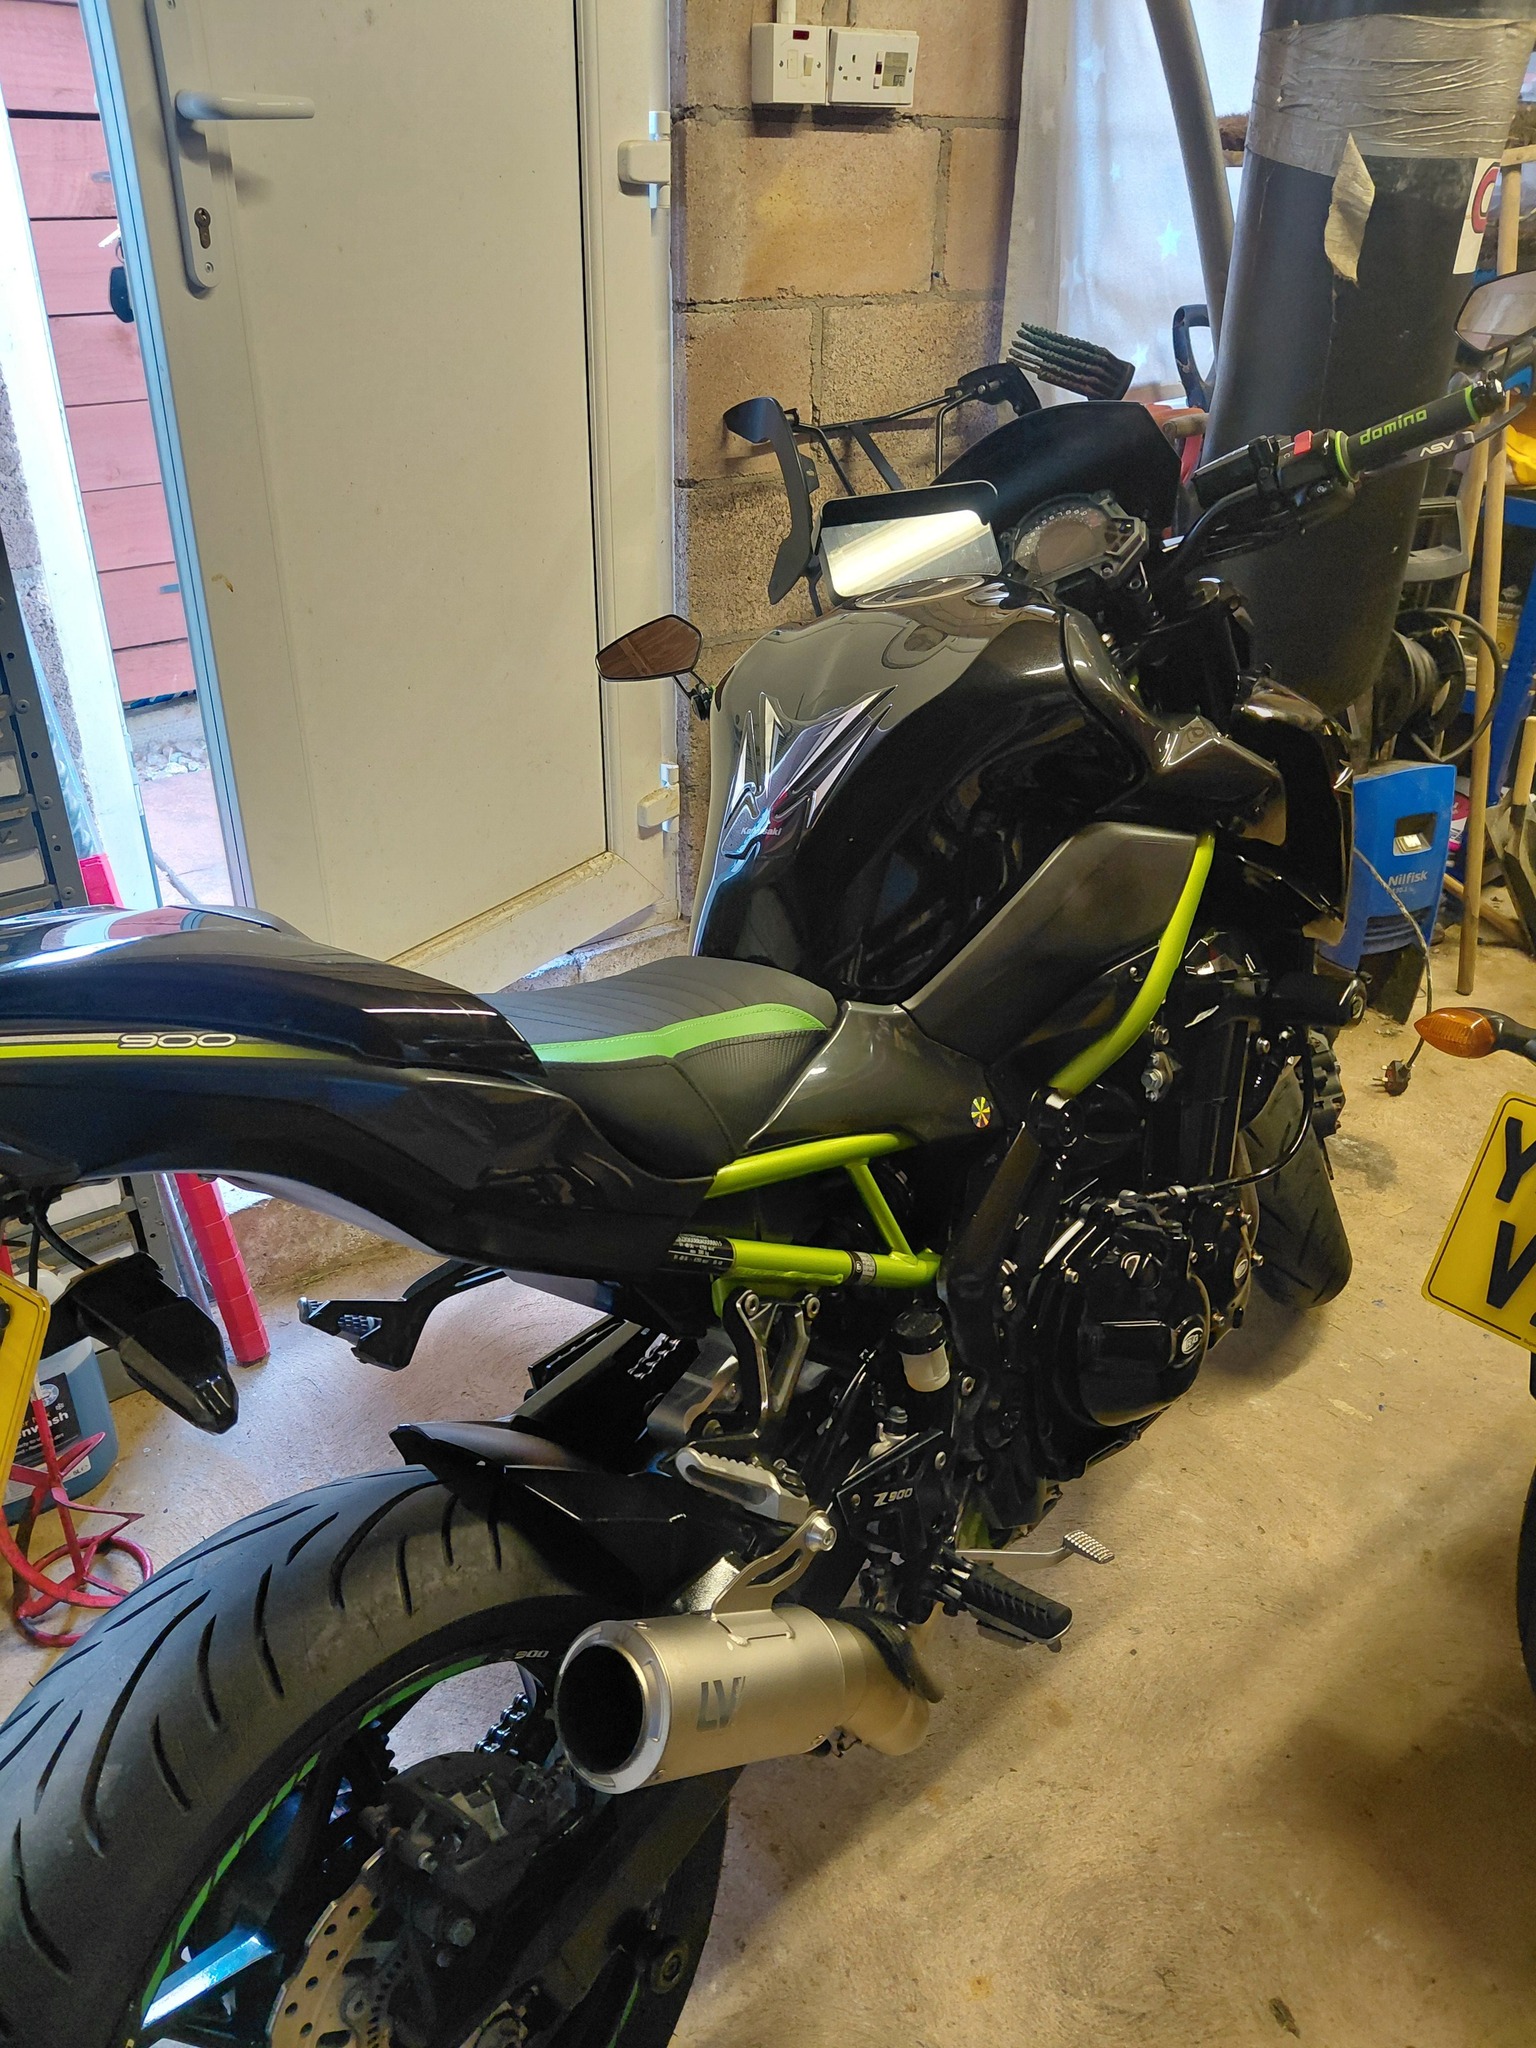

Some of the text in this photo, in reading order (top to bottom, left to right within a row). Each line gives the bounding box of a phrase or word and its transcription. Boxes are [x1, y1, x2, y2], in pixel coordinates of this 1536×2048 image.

[1360, 409, 1427, 445] domino
[1420, 439, 1454, 457] ASV
[740, 827, 782, 836] Kasaki
[1388, 870, 1428, 887] Nilfisk
[119, 1033, 236, 1048] 900
[873, 1487, 913, 1507] Z900
[514, 1650, 549, 1660] 900
